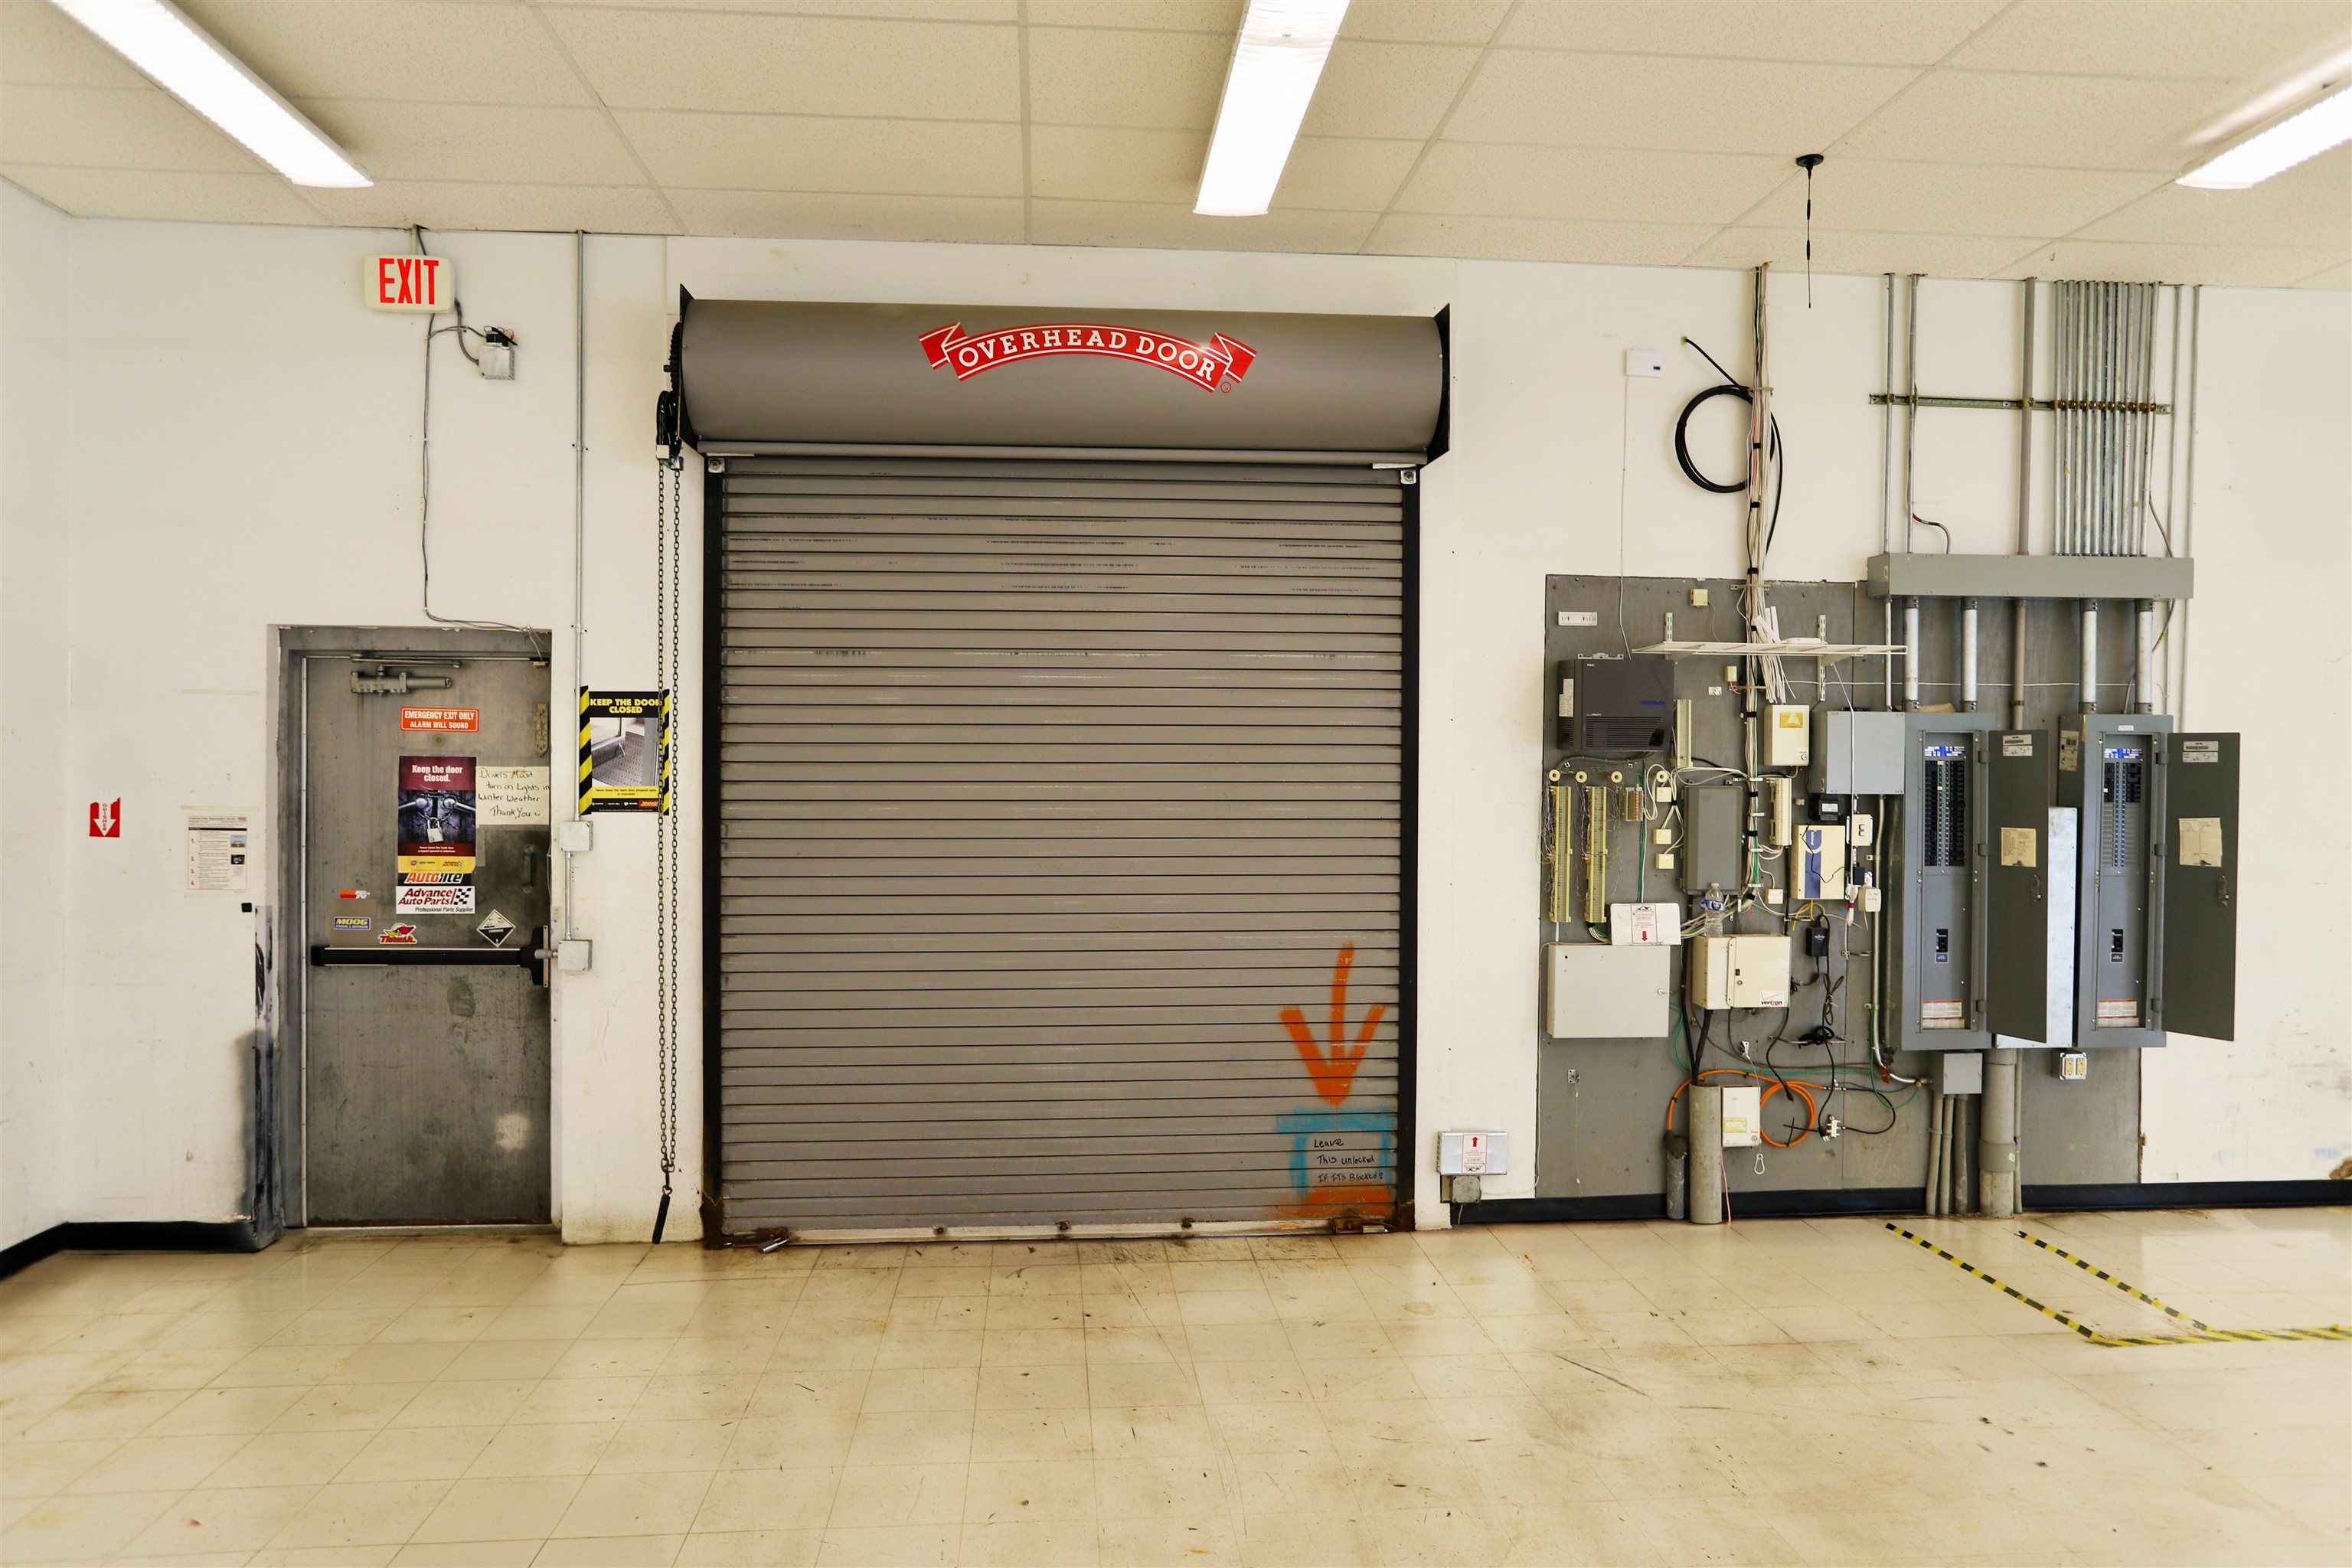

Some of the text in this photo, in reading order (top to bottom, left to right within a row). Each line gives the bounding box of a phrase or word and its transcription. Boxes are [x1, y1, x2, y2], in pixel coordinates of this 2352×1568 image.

[378, 257, 439, 305] EXIT
[958, 328, 1216, 382] OVERHEAD DOOR
[590, 698, 613, 707] KEEP
[615, 698, 632, 707] THE
[404, 710, 475, 720] EMERGENCY EXIT ONLY
[609, 706, 643, 714] CLOSED
[410, 720, 432, 729] ALARM
[448, 721, 469, 730] SOUND
[411, 764, 463, 774] Keep the door
[511, 769, 533, 779] Must
[423, 773, 451, 782] closed.
[489, 804, 531, 819] Thank You
[405, 888, 452, 897] Advance
[1314, 1138, 1344, 1148] Leave
[1317, 1154, 1338, 1165] This
